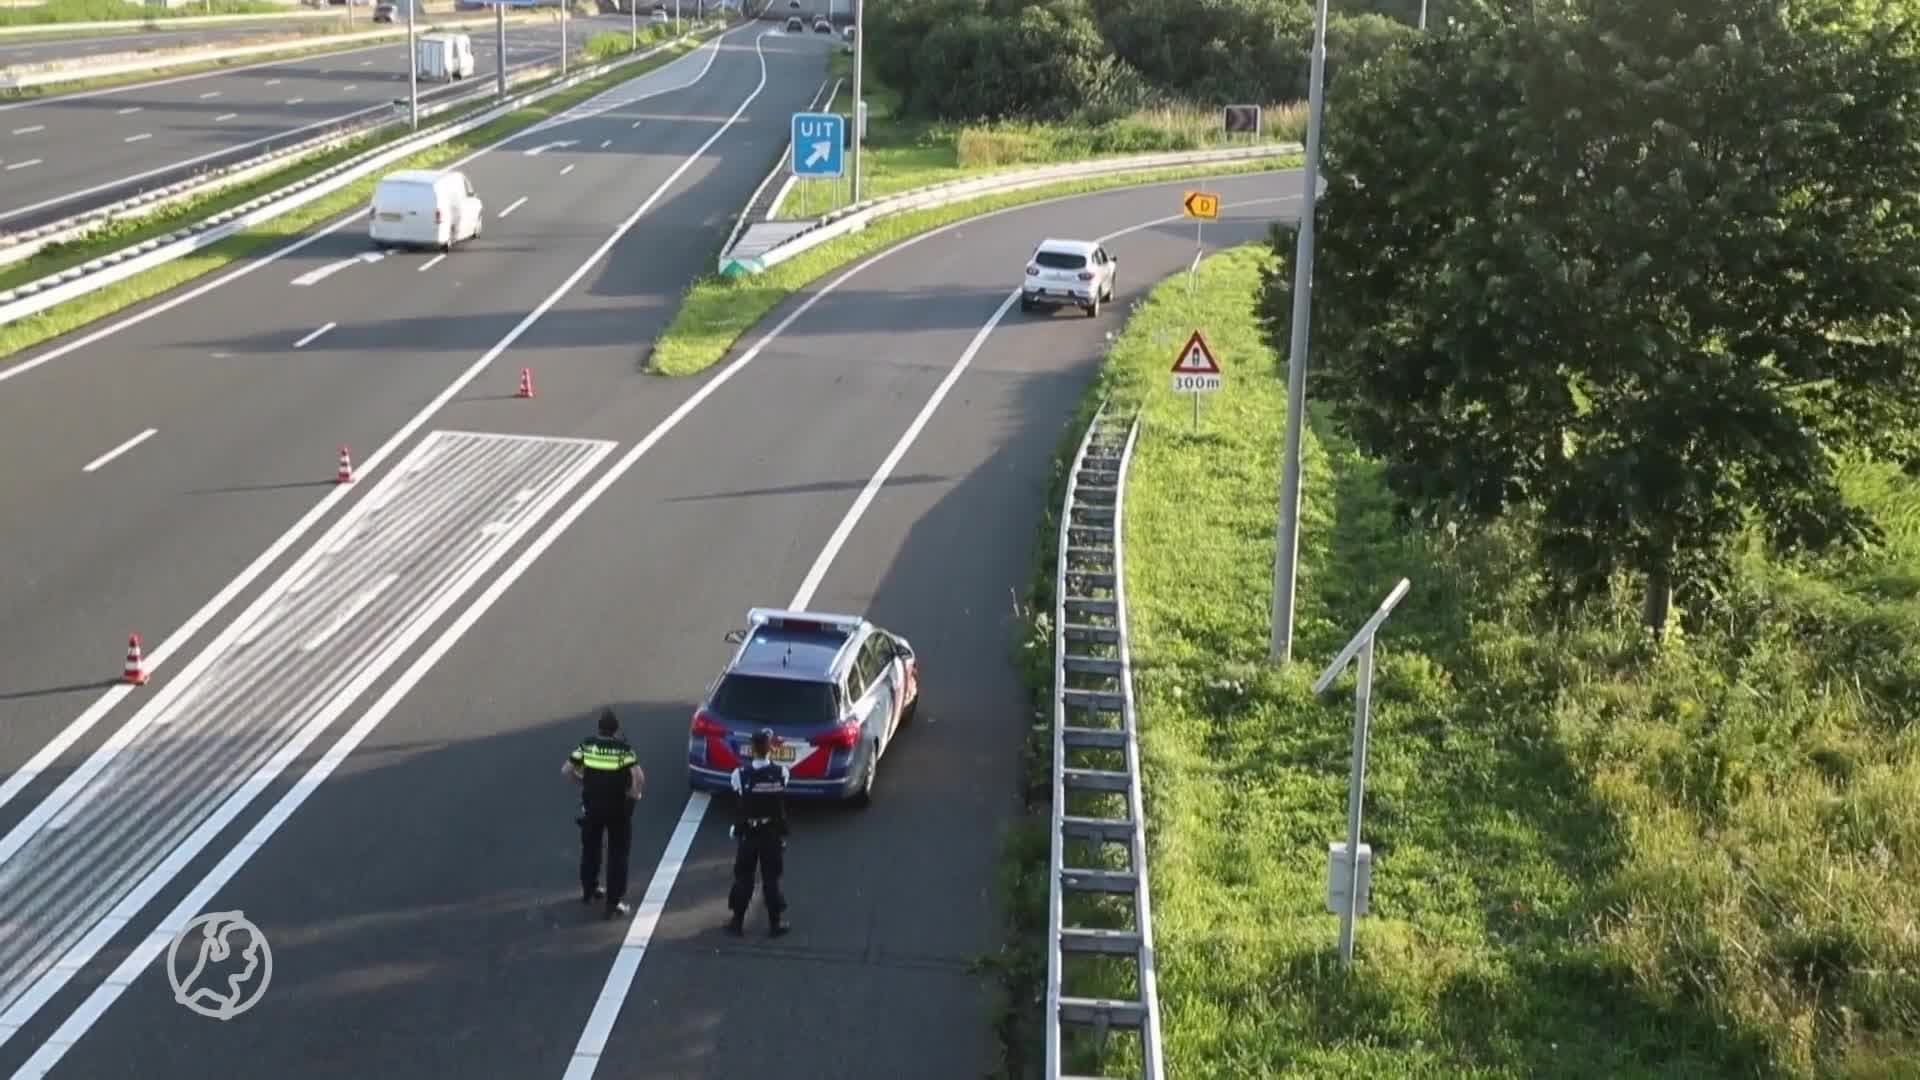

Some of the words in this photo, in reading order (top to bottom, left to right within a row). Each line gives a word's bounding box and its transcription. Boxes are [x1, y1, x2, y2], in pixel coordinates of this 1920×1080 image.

[801, 121, 834, 137] UIT
[1201, 200, 1210, 212] D
[1175, 376, 1219, 390] 300m
